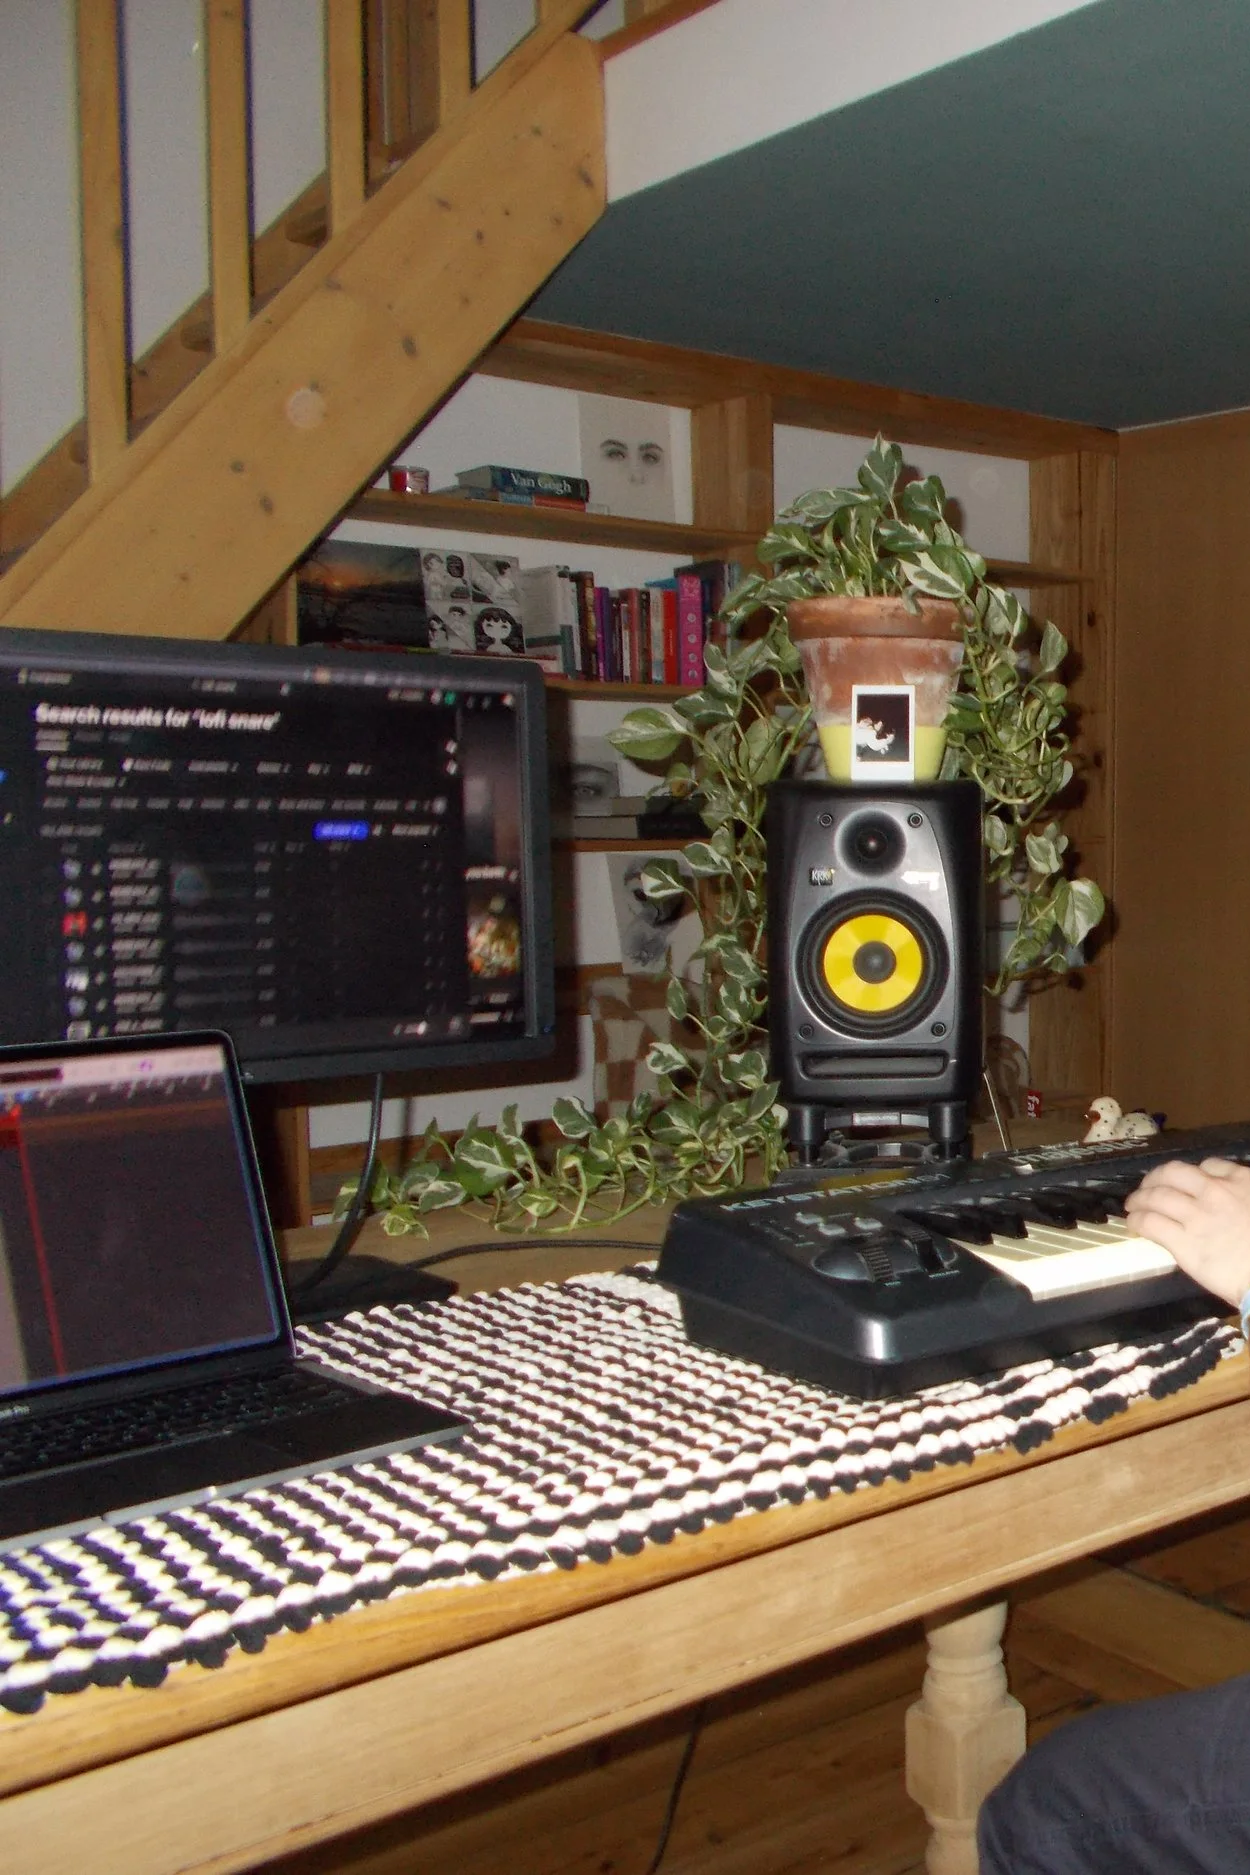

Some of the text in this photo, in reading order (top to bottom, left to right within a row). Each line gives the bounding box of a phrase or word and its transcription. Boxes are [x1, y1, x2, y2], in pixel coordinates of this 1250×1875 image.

[510, 472, 572, 496] Van Gogh
[35, 702, 101, 724] Search
[102, 705, 164, 728] results
[165, 706, 191, 728] for
